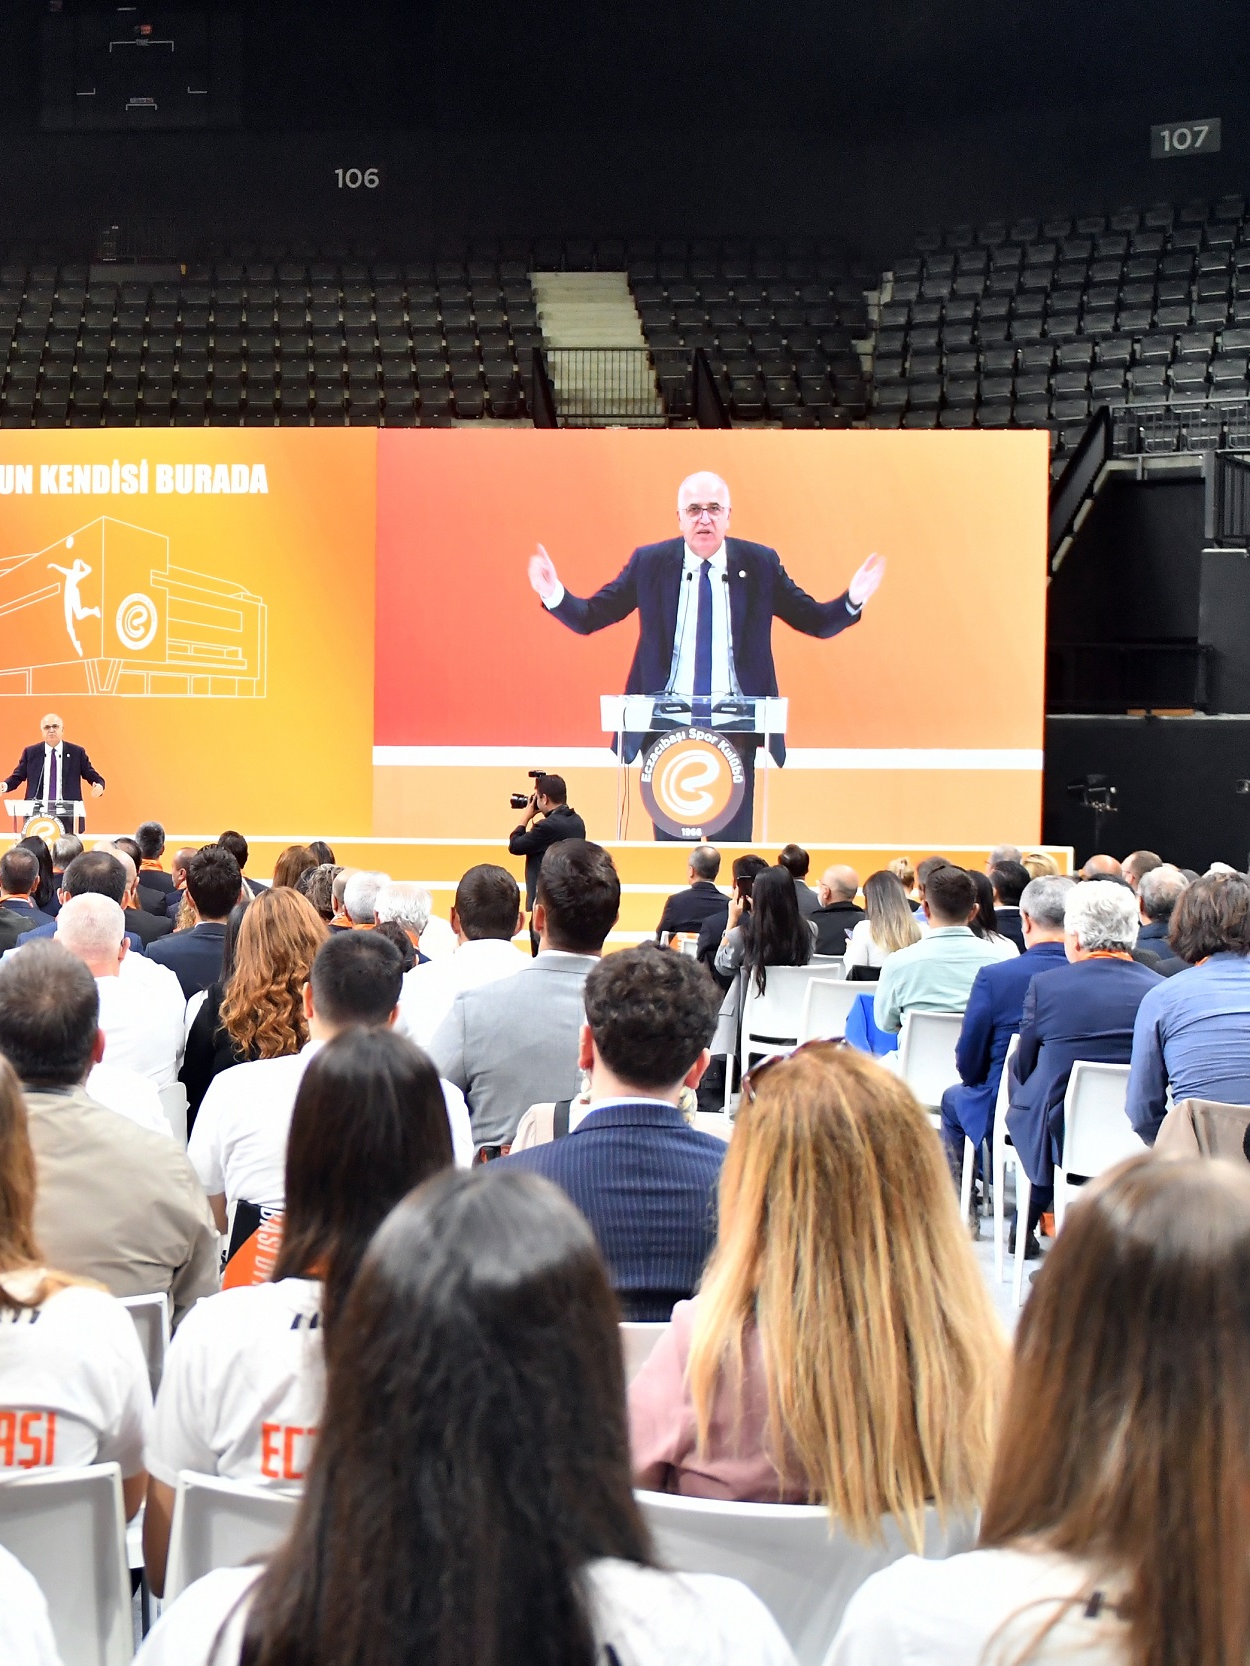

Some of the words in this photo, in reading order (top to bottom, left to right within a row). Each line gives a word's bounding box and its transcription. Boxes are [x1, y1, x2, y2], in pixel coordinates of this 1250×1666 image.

[1160, 125, 1209, 152] 107
[334, 168, 380, 188] 106
[40, 458, 149, 495] KENDİSİ
[155, 463, 269, 494] BURADA
[688, 727, 719, 745] Spor
